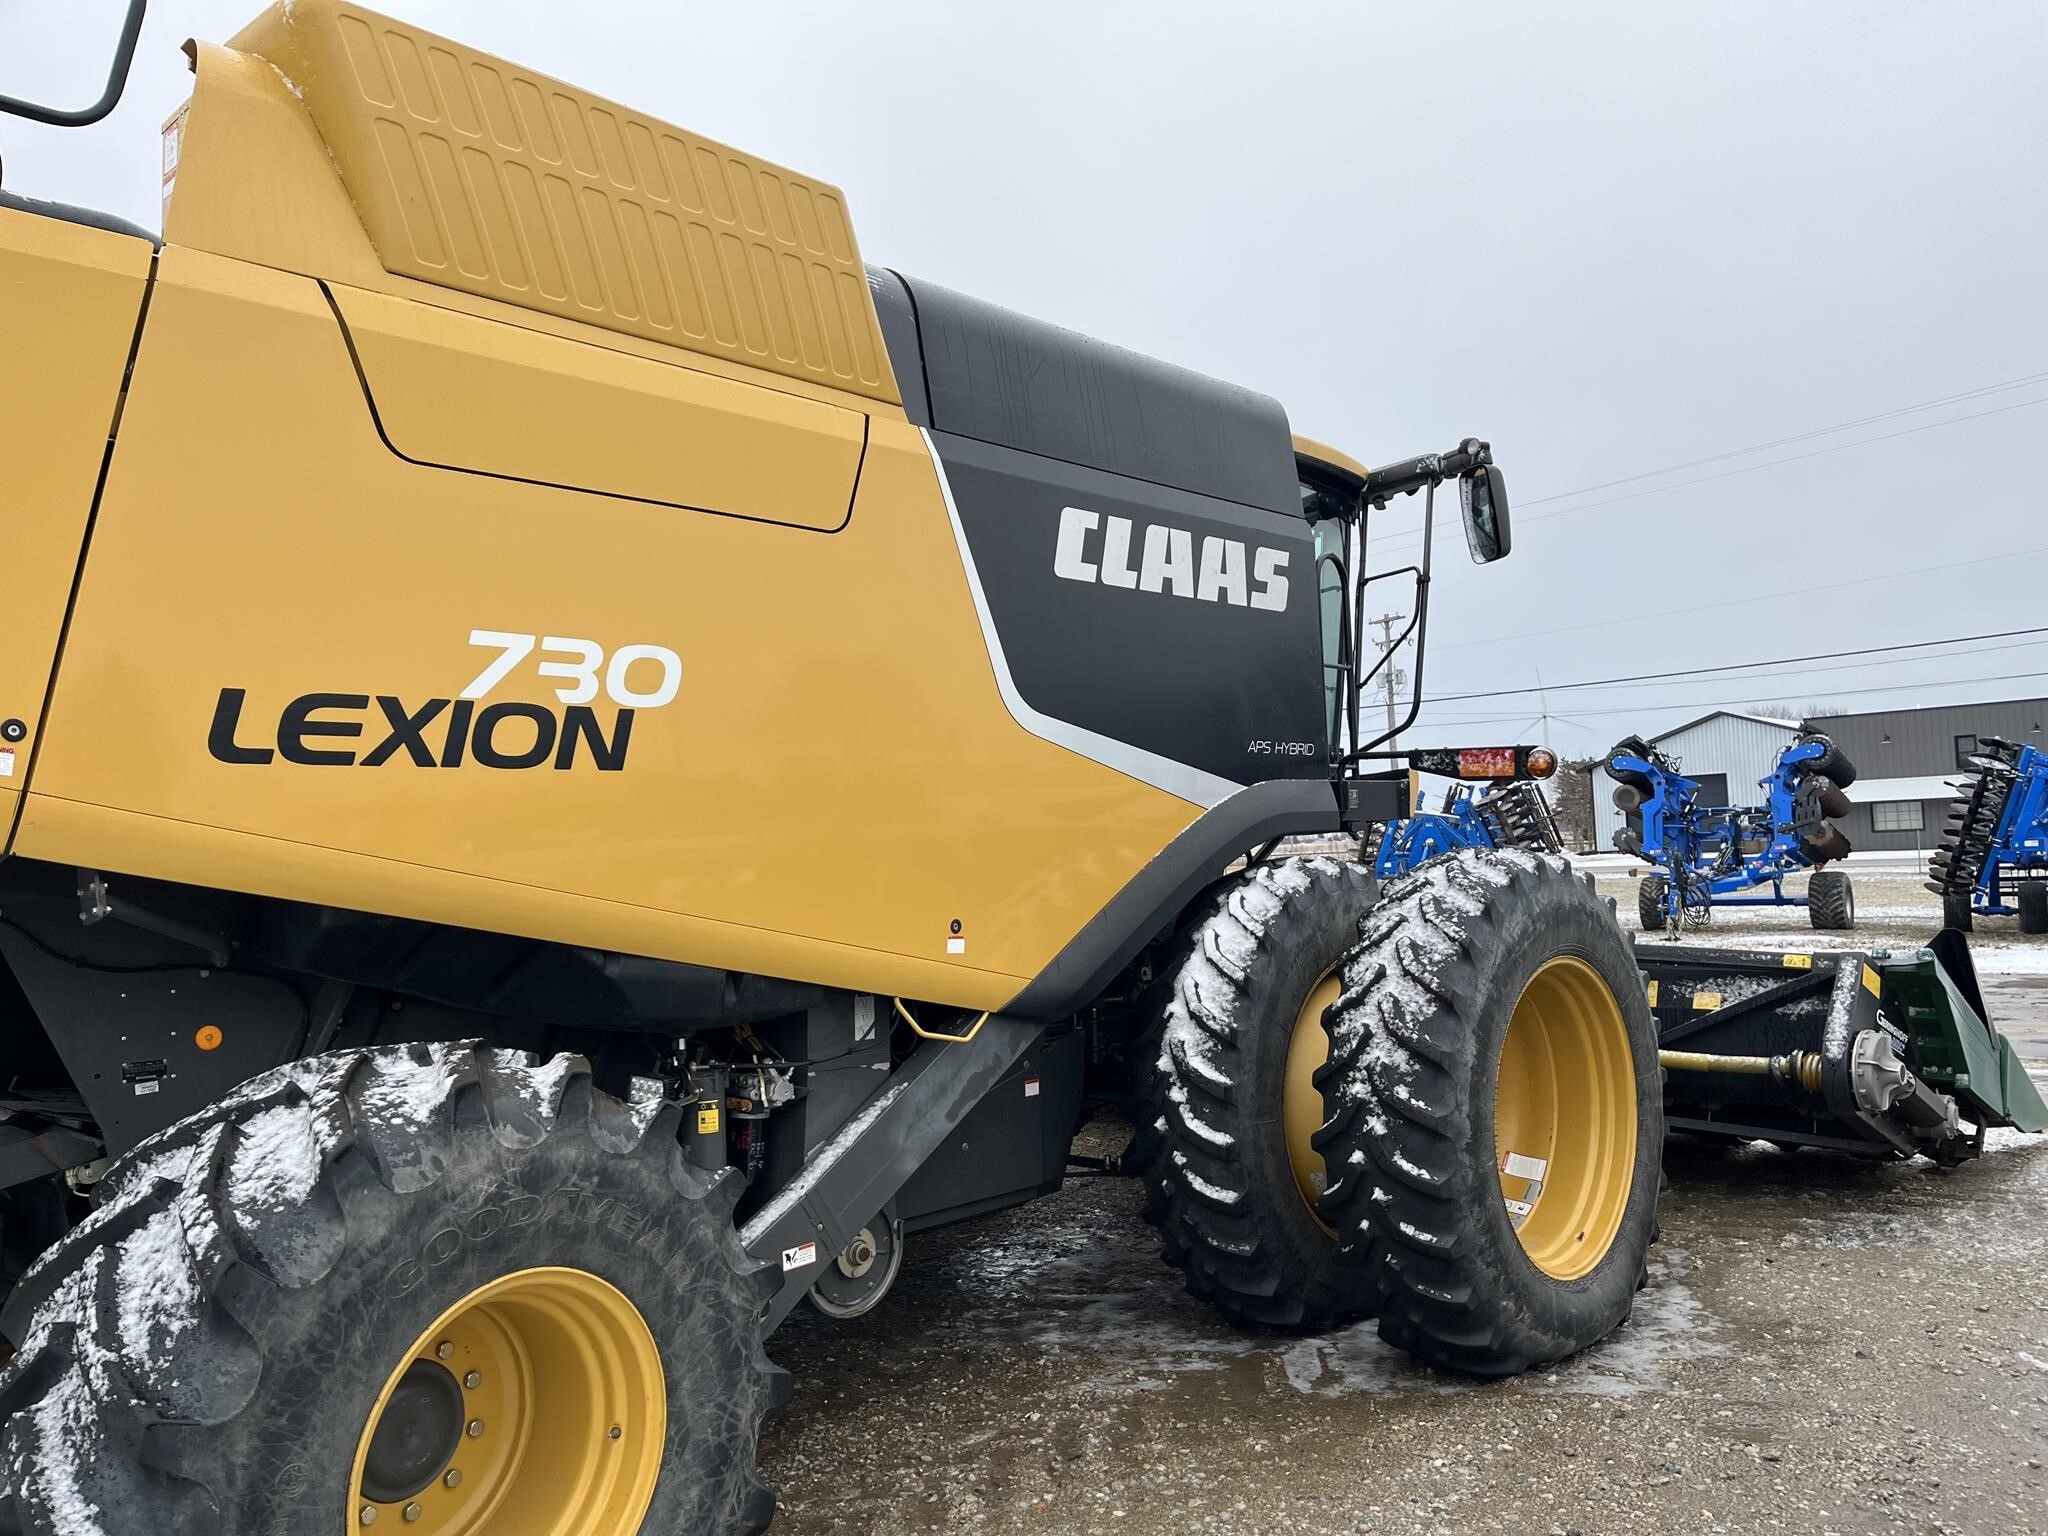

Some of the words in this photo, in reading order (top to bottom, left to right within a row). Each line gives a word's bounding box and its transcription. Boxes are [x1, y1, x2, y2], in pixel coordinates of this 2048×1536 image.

[1053, 506, 1290, 613] CLAAS
[458, 629, 683, 708] 730
[207, 687, 635, 771] LEXION
[1247, 740, 1272, 754] APS
[1274, 742, 1315, 756] HYBRID
[384, 1187, 692, 1299] GOODYEAR
